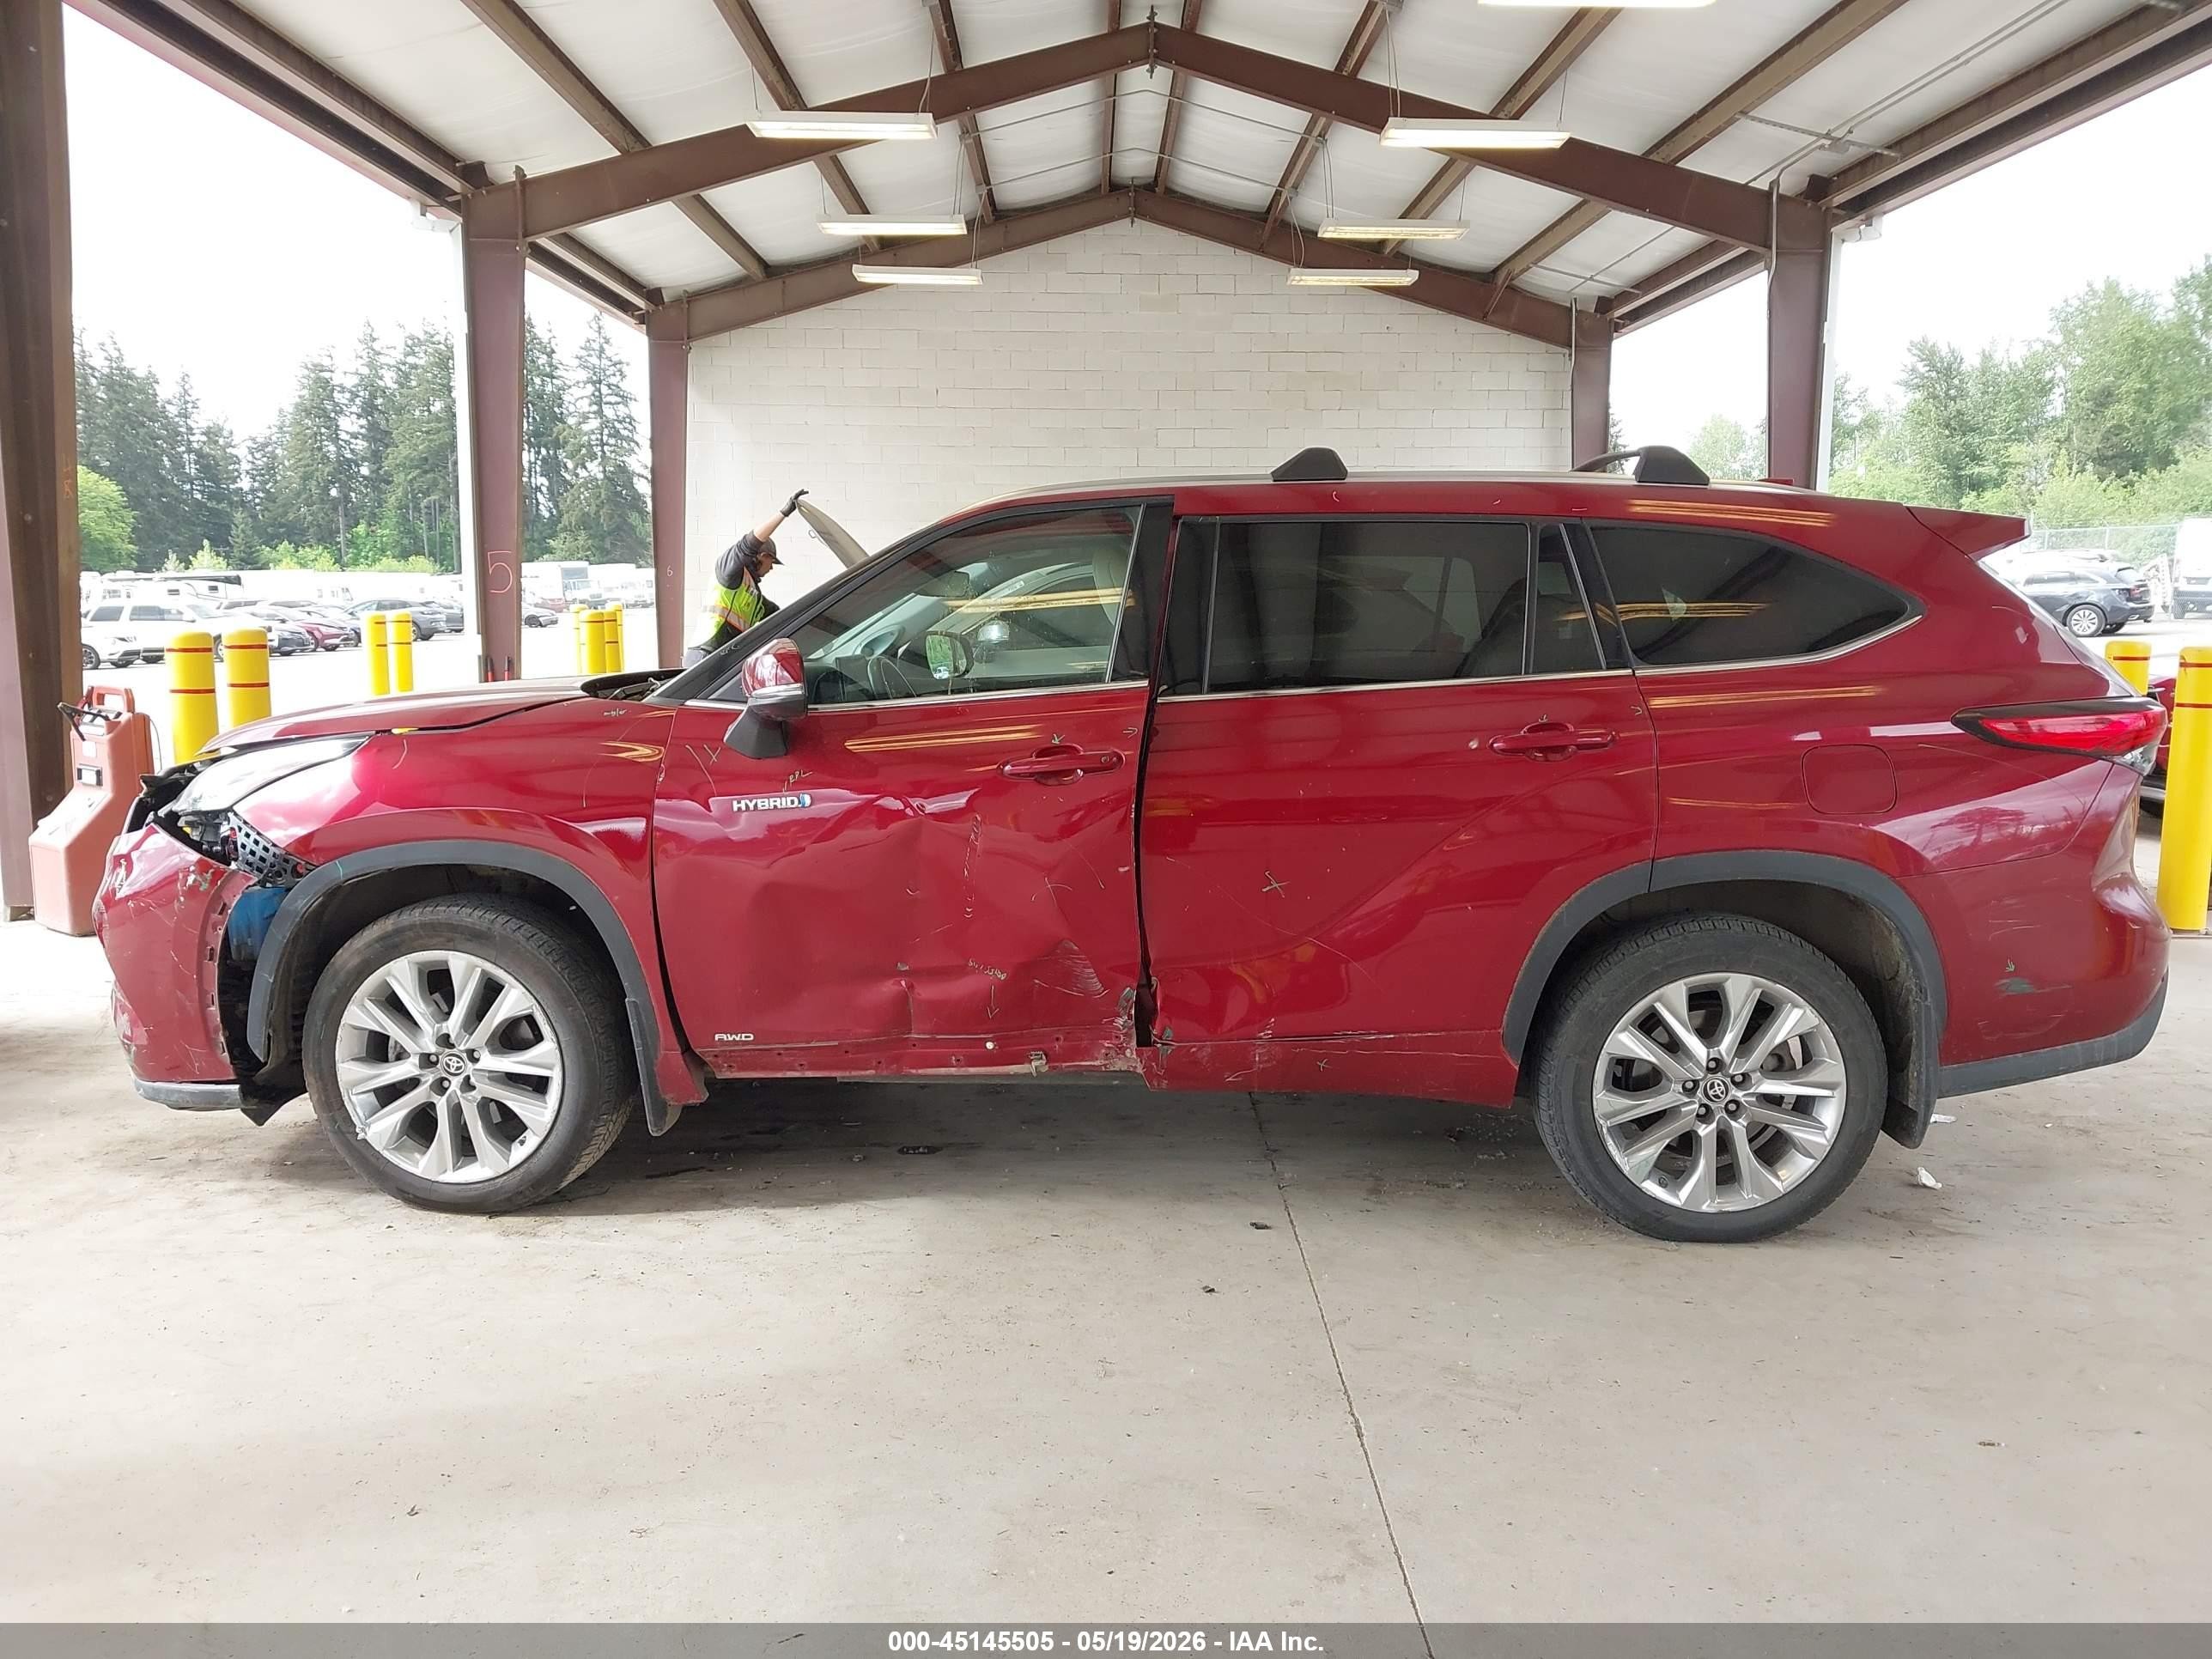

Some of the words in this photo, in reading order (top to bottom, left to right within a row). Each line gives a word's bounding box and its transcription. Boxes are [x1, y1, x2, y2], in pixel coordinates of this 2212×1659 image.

[487, 550, 514, 593] 5
[666, 564, 674, 577] 6
[732, 796, 799, 812] HYBRID
[714, 1033, 754, 1042] AWD
